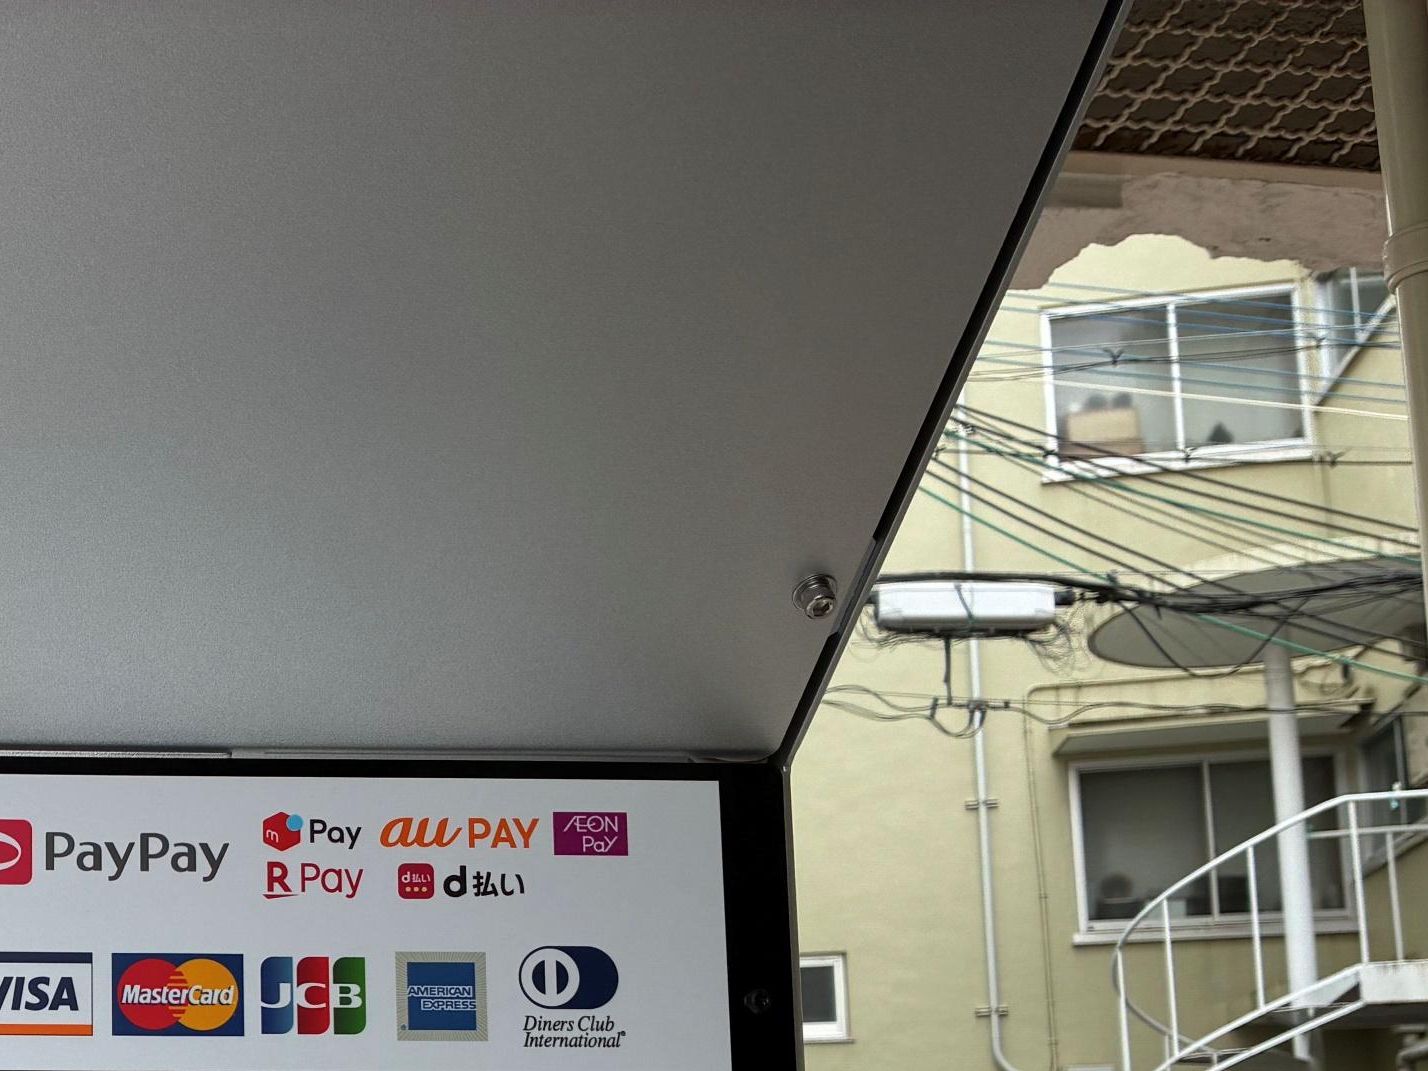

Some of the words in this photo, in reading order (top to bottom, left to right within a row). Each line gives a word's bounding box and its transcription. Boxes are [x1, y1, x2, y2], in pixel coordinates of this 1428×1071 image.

[309, 819, 362, 850] Pay
[379, 817, 462, 848] au
[468, 818, 539, 849] PAY
[45, 832, 230, 882] PayPay
[267, 861, 293, 893] R
[300, 862, 364, 899] Pay
[401, 871, 431, 883] d払い
[443, 865, 525, 898] d払い
[121, 984, 235, 1006] MasterCard
[261, 982, 363, 1009] JCB
[408, 986, 472, 997] AMERICAN
[421, 1000, 476, 1010] EXPRESS
[523, 1015, 574, 1031] Diners
[578, 1015, 615, 1031] Club
